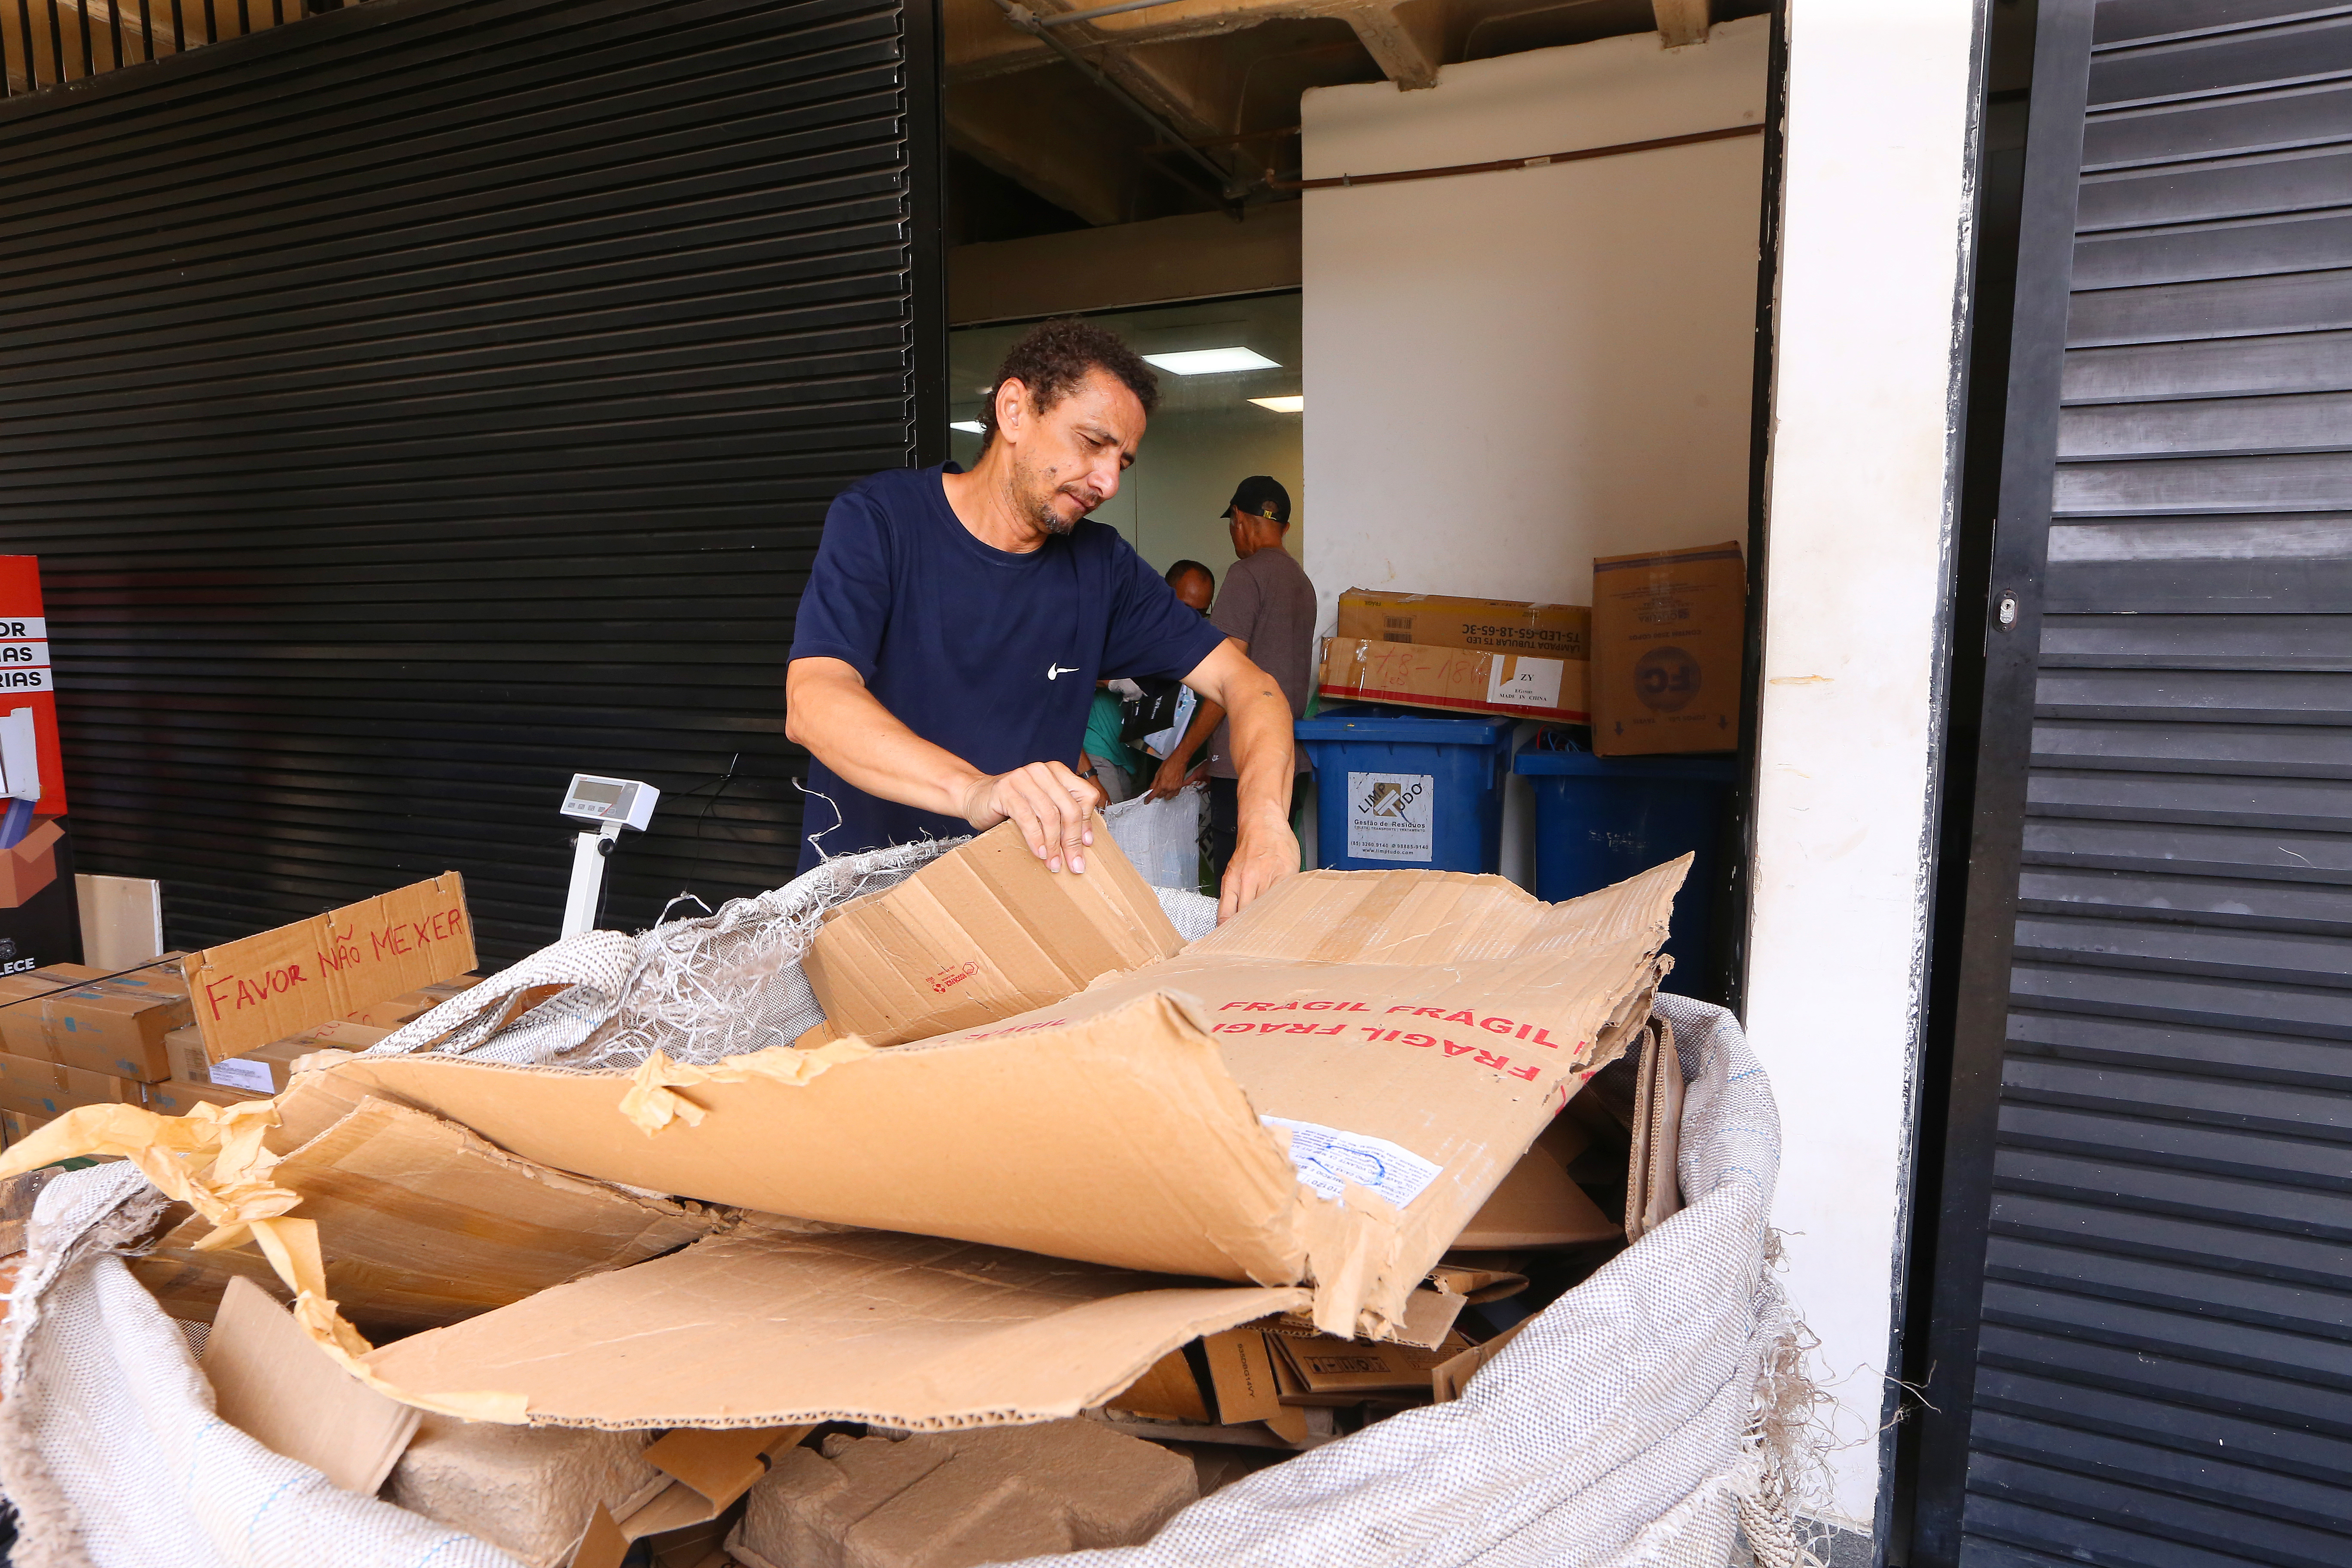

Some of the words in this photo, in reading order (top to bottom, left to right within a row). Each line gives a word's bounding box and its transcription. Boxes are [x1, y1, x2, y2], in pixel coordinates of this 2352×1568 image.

[1462, 623, 1580, 643] T5-LED-G5-18-65-3C
[1466, 636, 1482, 645] LED
[1483, 637, 1494, 646] T5
[1496, 638, 1535, 649] TUBULAR
[1520, 674, 1534, 682] ZY
[1644, 665, 1691, 694] FC
[206, 964, 307, 1021] FAVOR
[318, 923, 361, 978] NÃO
[371, 909, 463, 962] MEXER
[1218, 999, 1371, 1012] FRÁGIL
[1385, 1005, 1558, 1049] FRÁGIL
[1360, 1026, 1542, 1081] FRÁGIL
